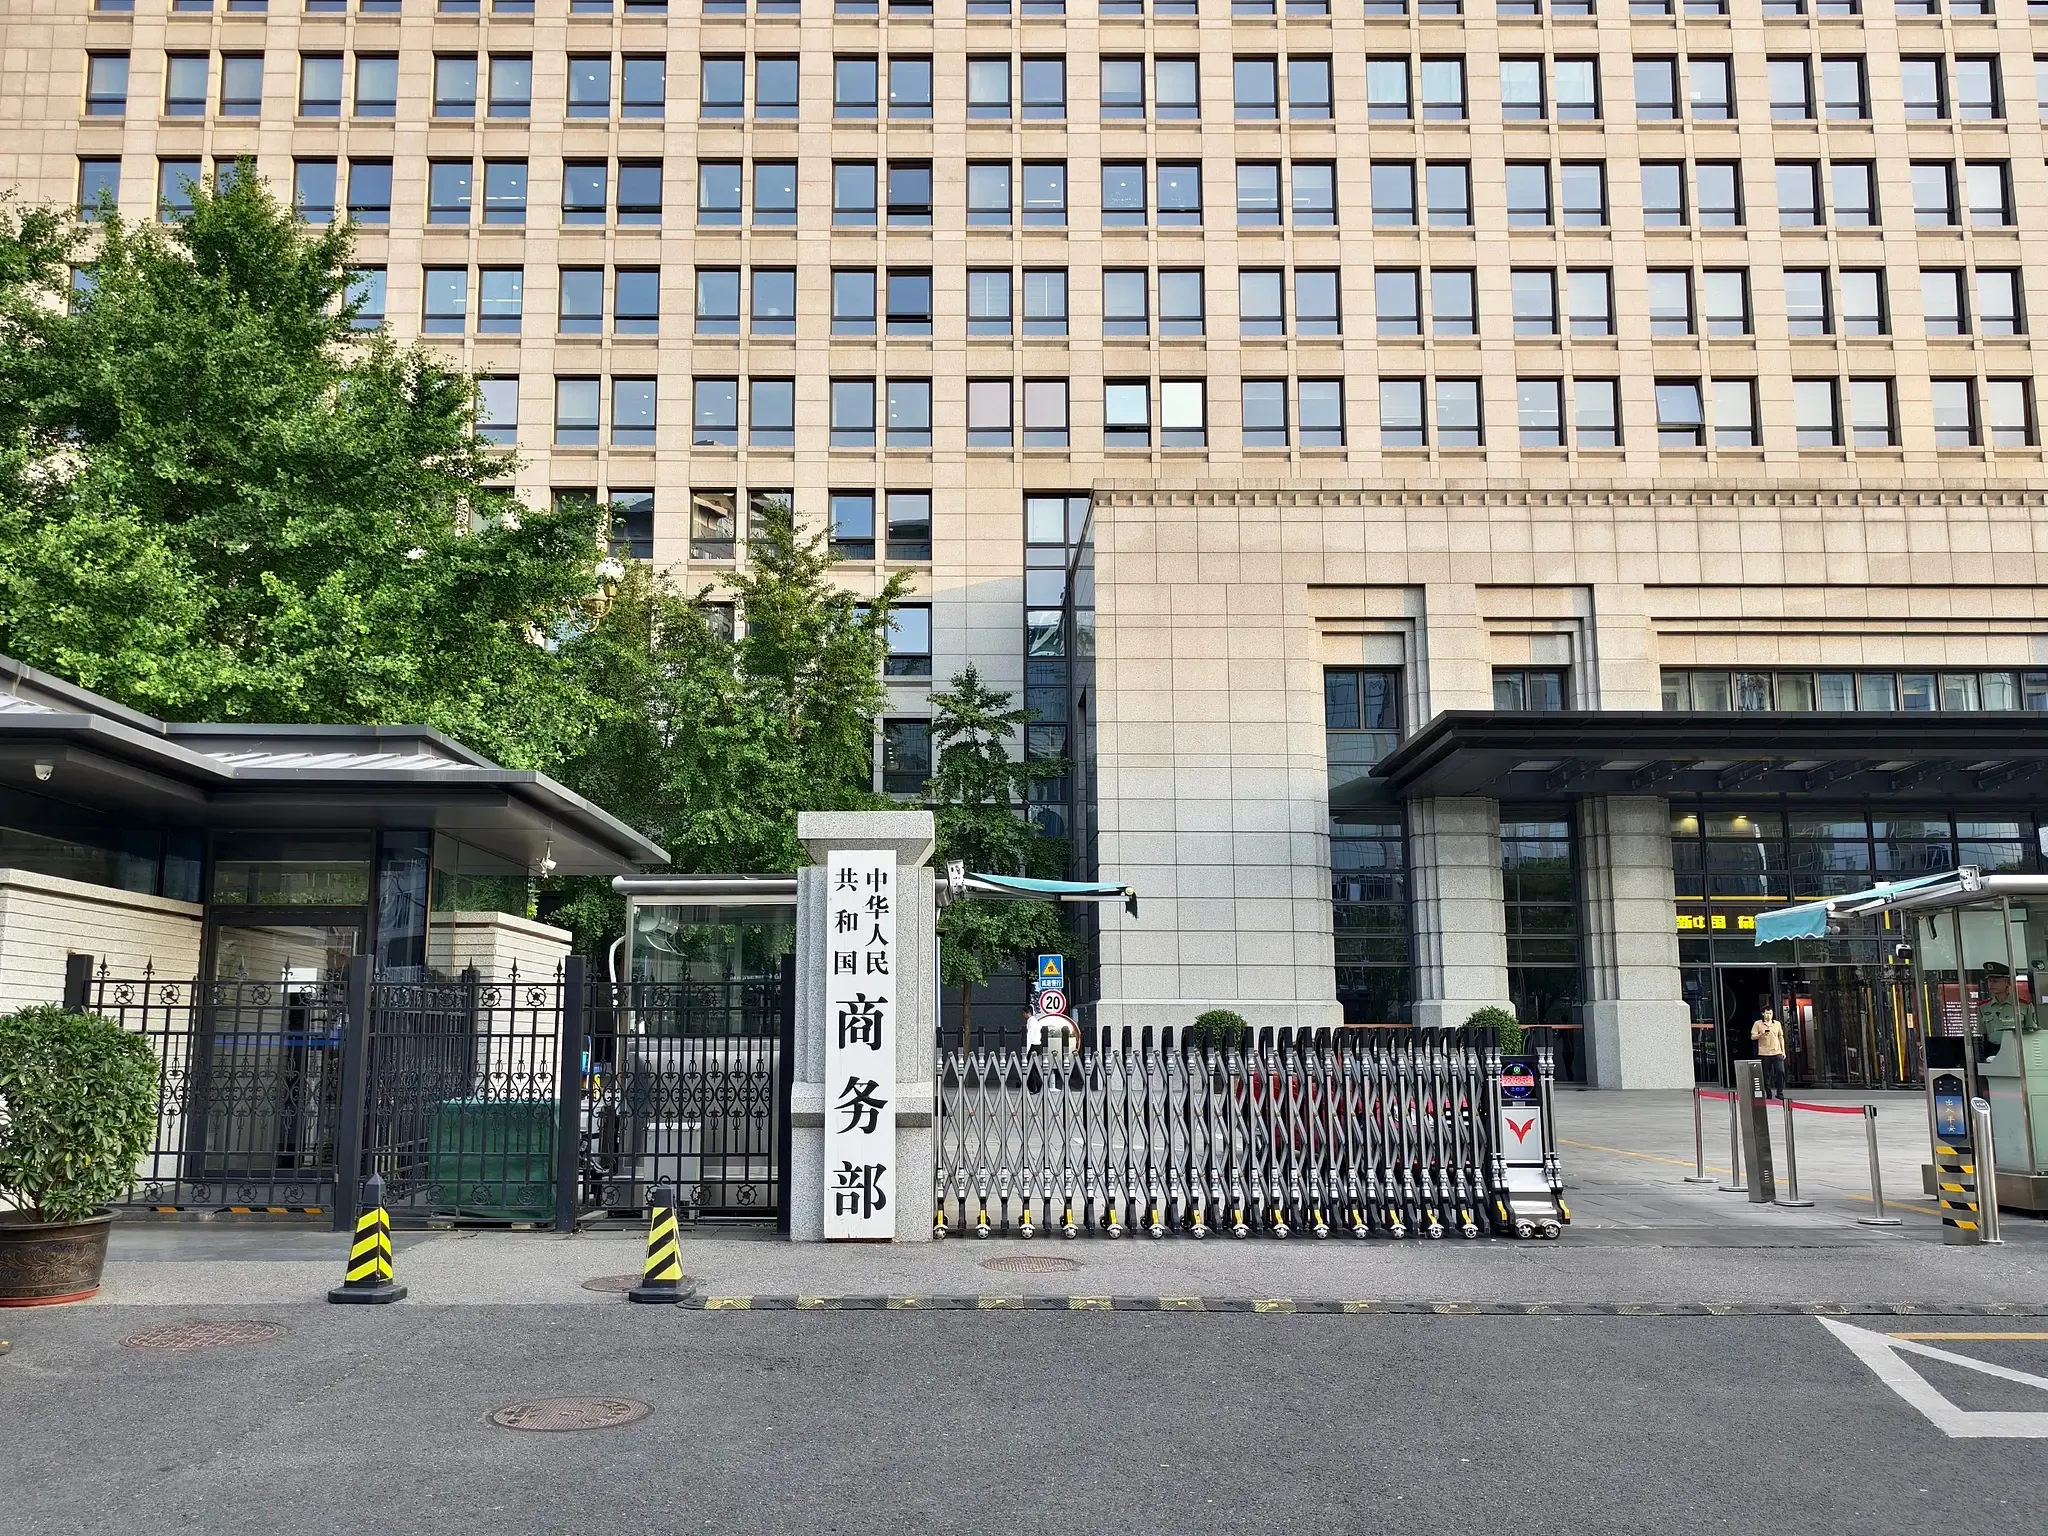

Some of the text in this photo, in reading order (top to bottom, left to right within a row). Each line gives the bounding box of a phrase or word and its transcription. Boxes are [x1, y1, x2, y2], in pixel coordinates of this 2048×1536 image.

[834, 867, 858, 975] 共和国
[862, 867, 889, 975] 中华人民
[1045, 996, 1060, 1009] 20
[831, 992, 889, 1219] 商务部
[1945, 1098, 1956, 1133] 出入平安
